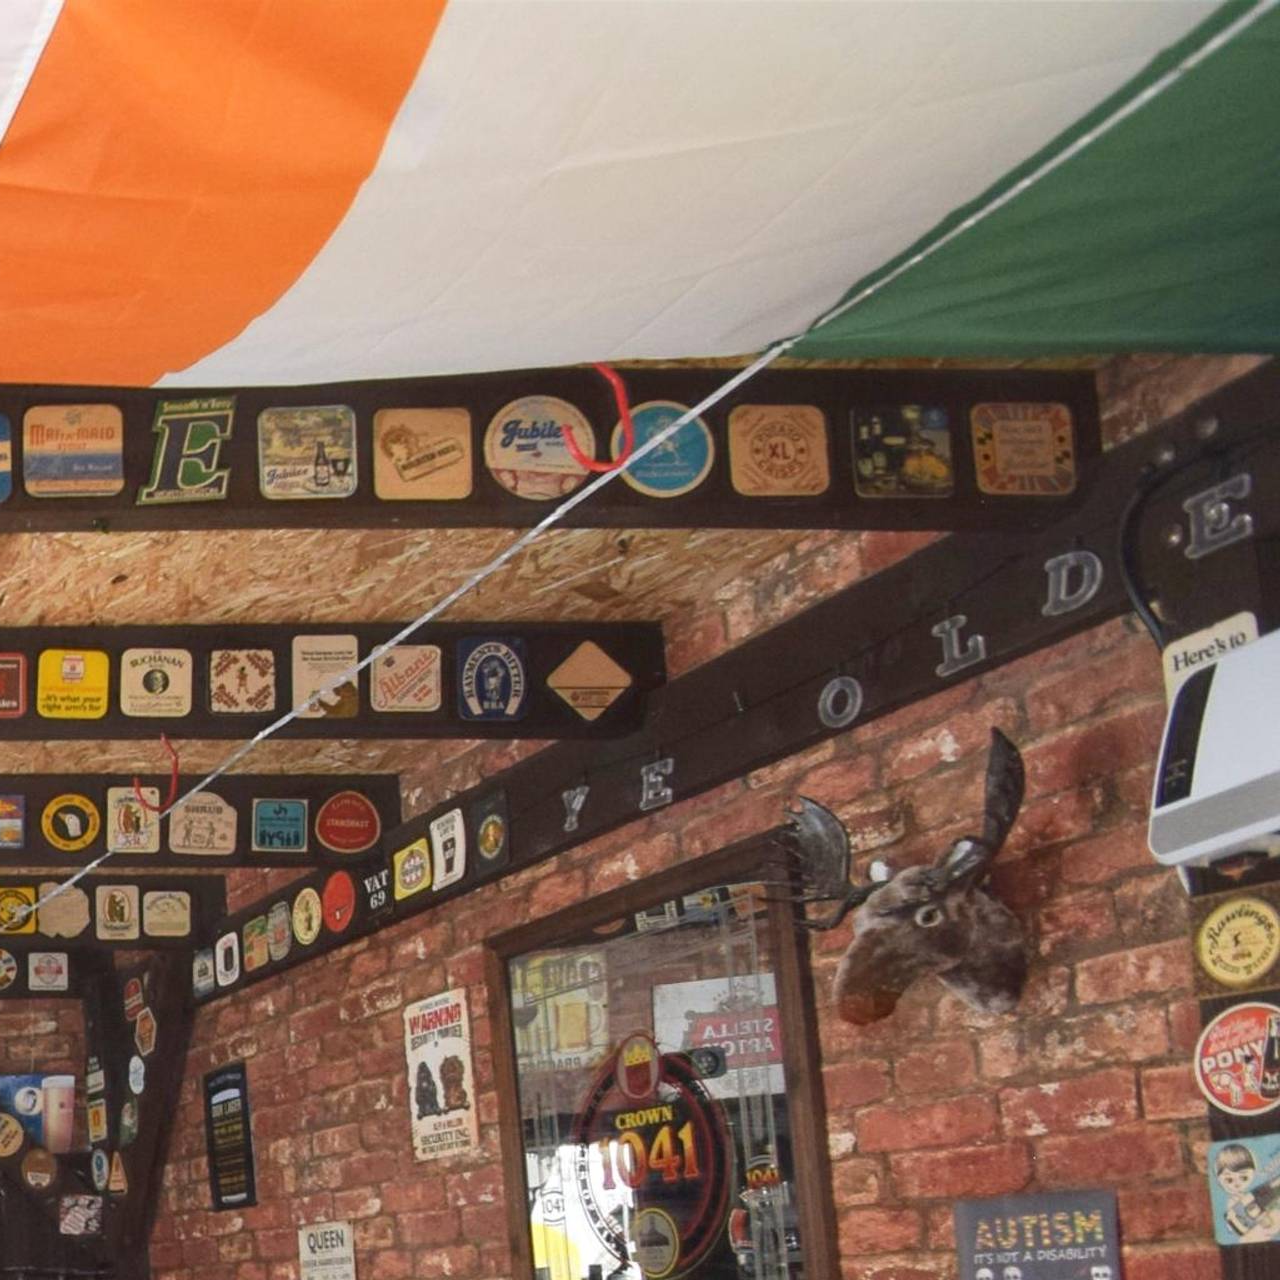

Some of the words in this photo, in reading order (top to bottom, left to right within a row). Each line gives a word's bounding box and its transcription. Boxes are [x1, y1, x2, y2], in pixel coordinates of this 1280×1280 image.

[767, 442, 791, 461] XL
[1172, 636, 1228, 673] Here's
[1229, 631, 1247, 651] to
[363, 868, 389, 895] VAT
[369, 890, 386, 910] 69
[408, 1003, 462, 1036] WARNING
[1201, 1039, 1264, 1075] PONY
[614, 1104, 675, 1131] CROWN
[598, 1120, 701, 1191] 1041
[307, 1229, 345, 1254] QUEEN
[974, 1209, 1105, 1250] AUTISM
[973, 1251, 994, 1265] IT'S
[996, 1250, 1019, 1264] NOT
[1022, 1250, 1035, 1263] A
[1036, 1244, 1108, 1262] DISABILITY
